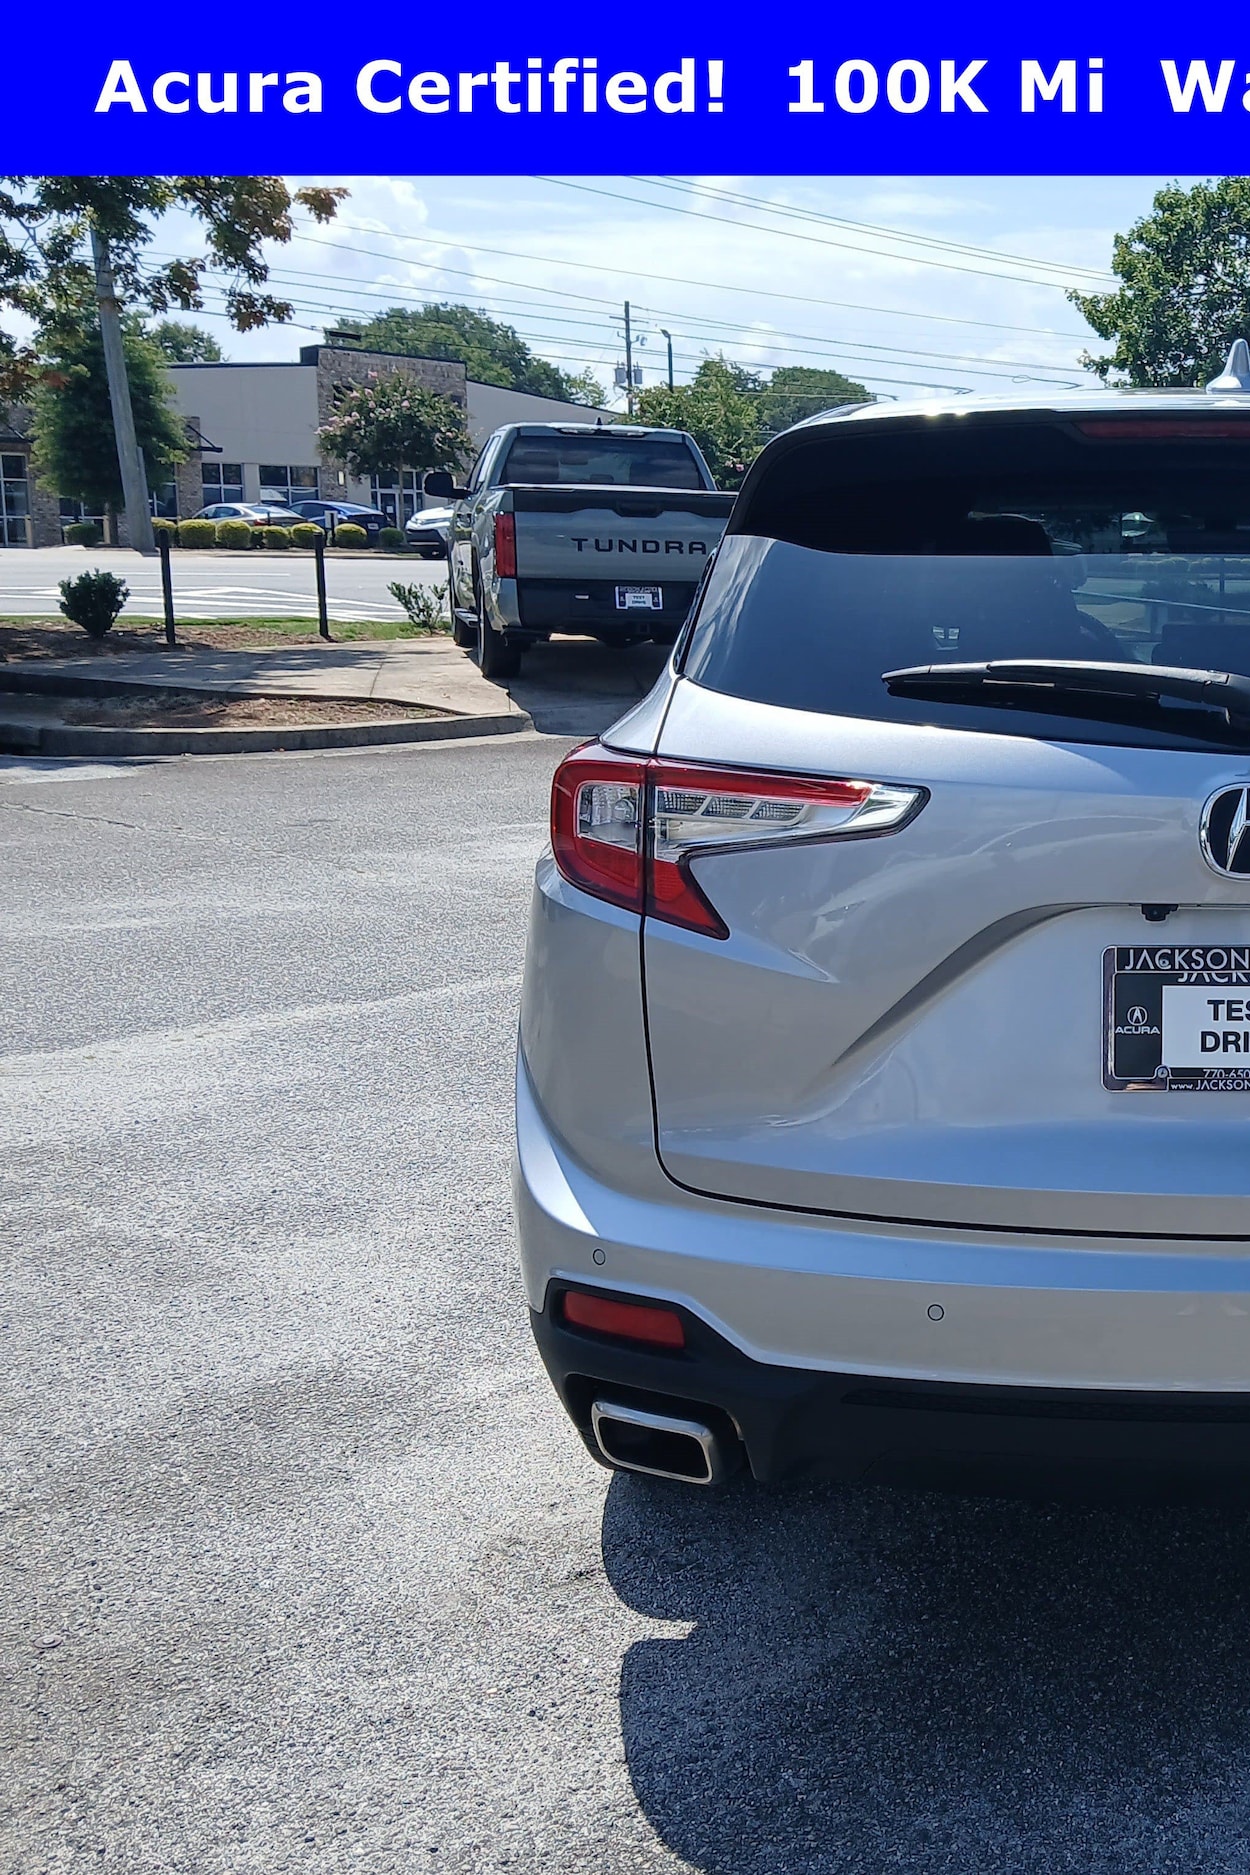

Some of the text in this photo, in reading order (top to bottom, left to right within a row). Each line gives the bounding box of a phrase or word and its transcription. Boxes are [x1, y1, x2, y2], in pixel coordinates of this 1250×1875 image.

[571, 538, 707, 555] TUNDRA
[1124, 948, 1250, 970] JACKSON
[1115, 1026, 1161, 1035] ACURA
